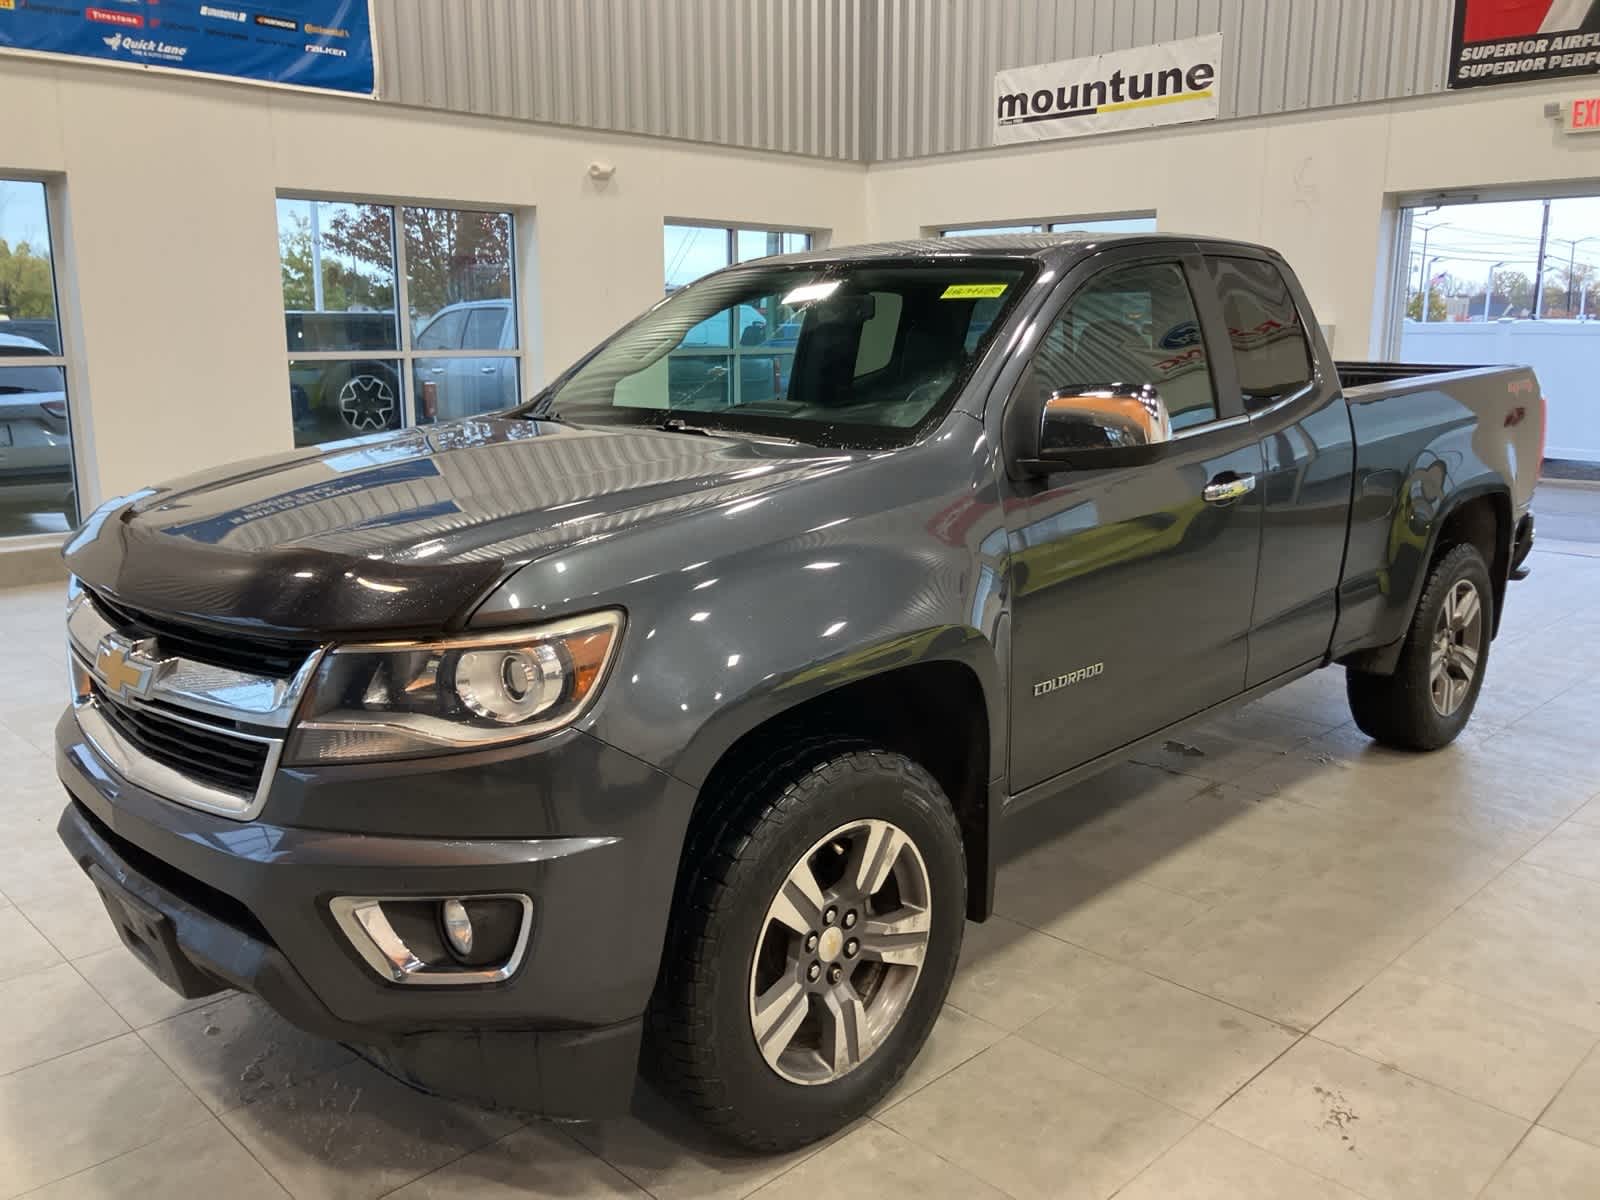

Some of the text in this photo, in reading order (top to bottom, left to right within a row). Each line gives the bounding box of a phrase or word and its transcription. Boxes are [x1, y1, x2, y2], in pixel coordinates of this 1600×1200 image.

[92, 10, 138, 24] Firestone
[122, 37, 187, 56] Quick Lane
[305, 44, 347, 57] FALKEN
[1460, 39, 1548, 61] SUPERIOR
[1458, 57, 1547, 79] SUPERIOR
[998, 63, 1215, 119] mountune
[1034, 662, 1104, 697] COLORADO
